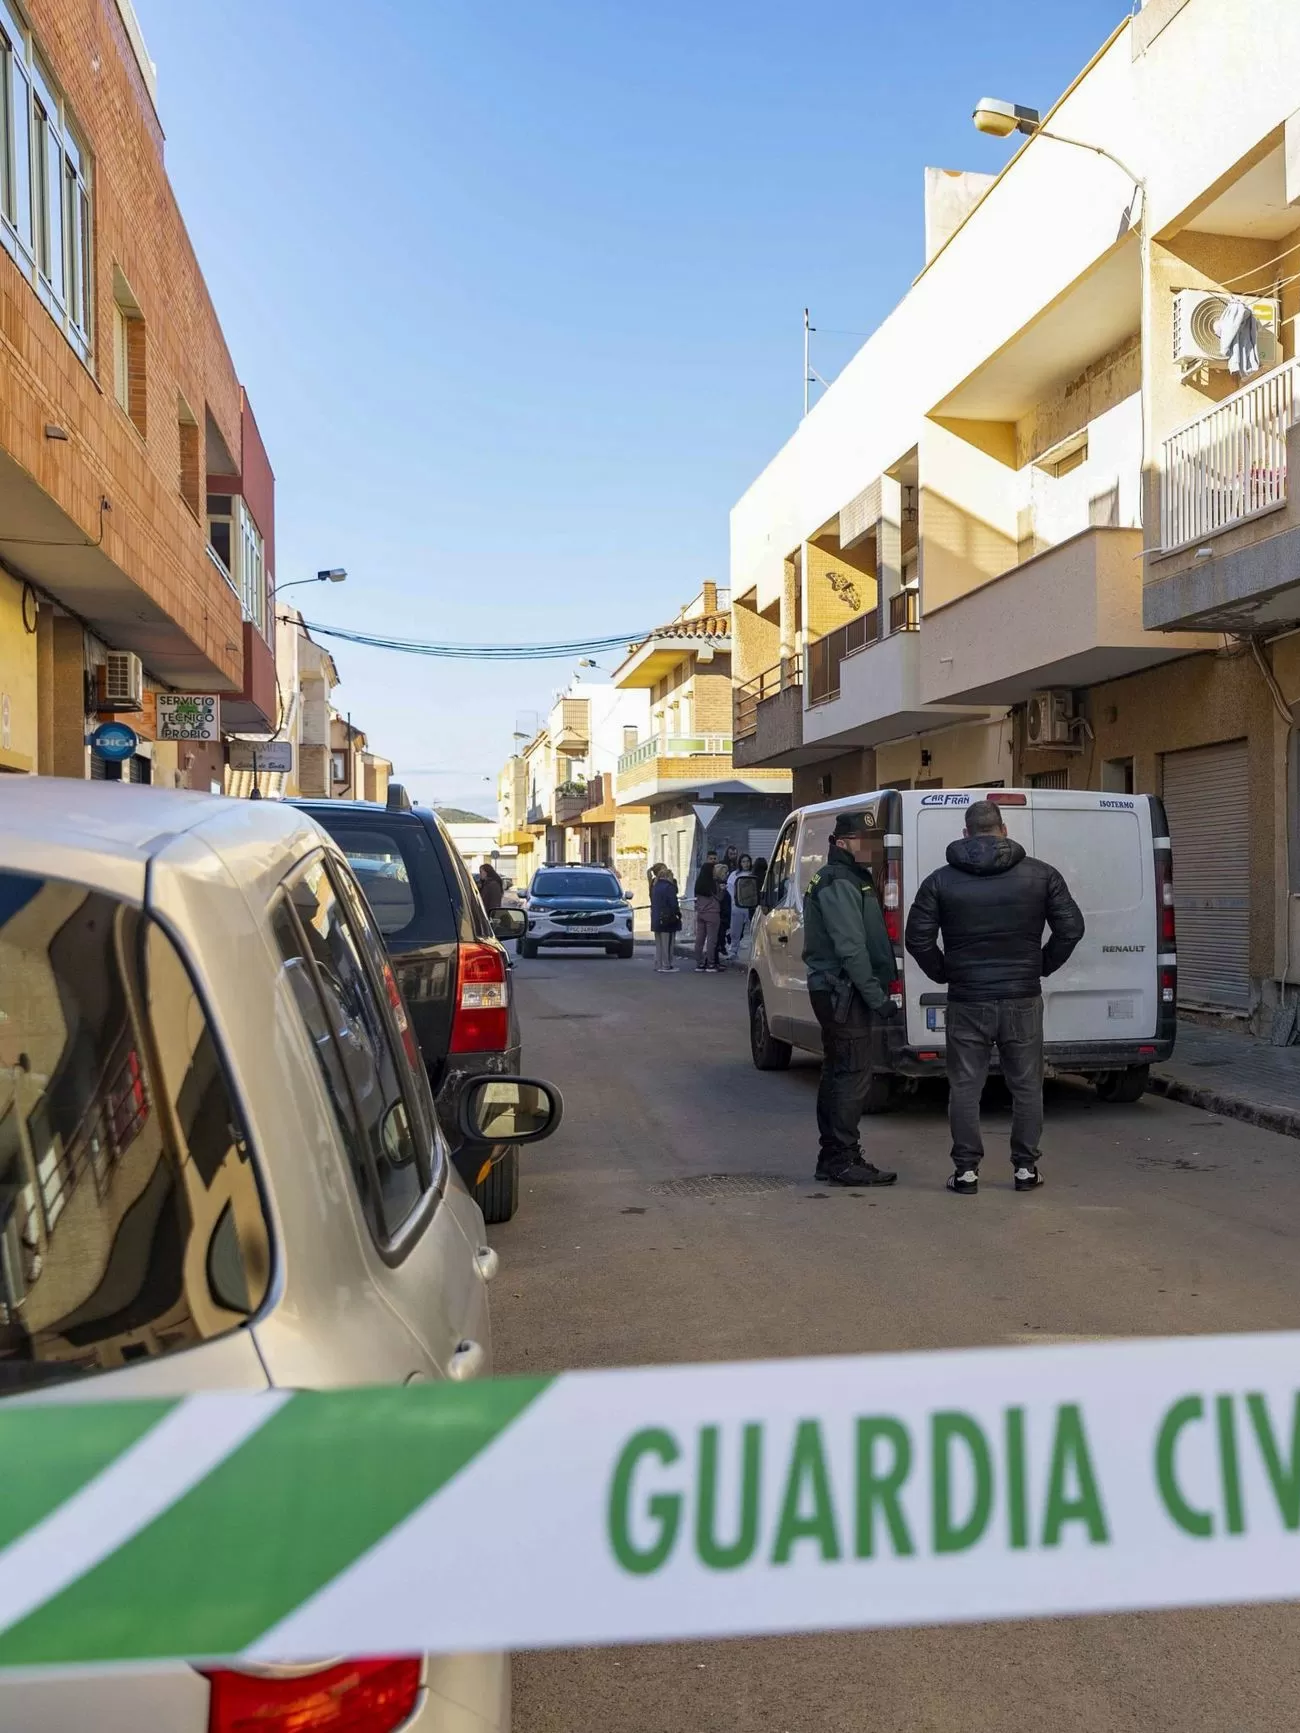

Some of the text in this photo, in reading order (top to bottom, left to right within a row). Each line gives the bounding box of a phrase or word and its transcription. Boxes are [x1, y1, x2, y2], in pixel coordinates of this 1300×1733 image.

[160, 695, 215, 706] SERVICIO
[160, 712, 215, 723] TECNICO
[164, 729, 211, 739] PROPIO
[1099, 800, 1134, 809] ISOTERMO
[1102, 945, 1146, 953] RENAULT
[608, 1402, 1110, 1577] GUARDIA
